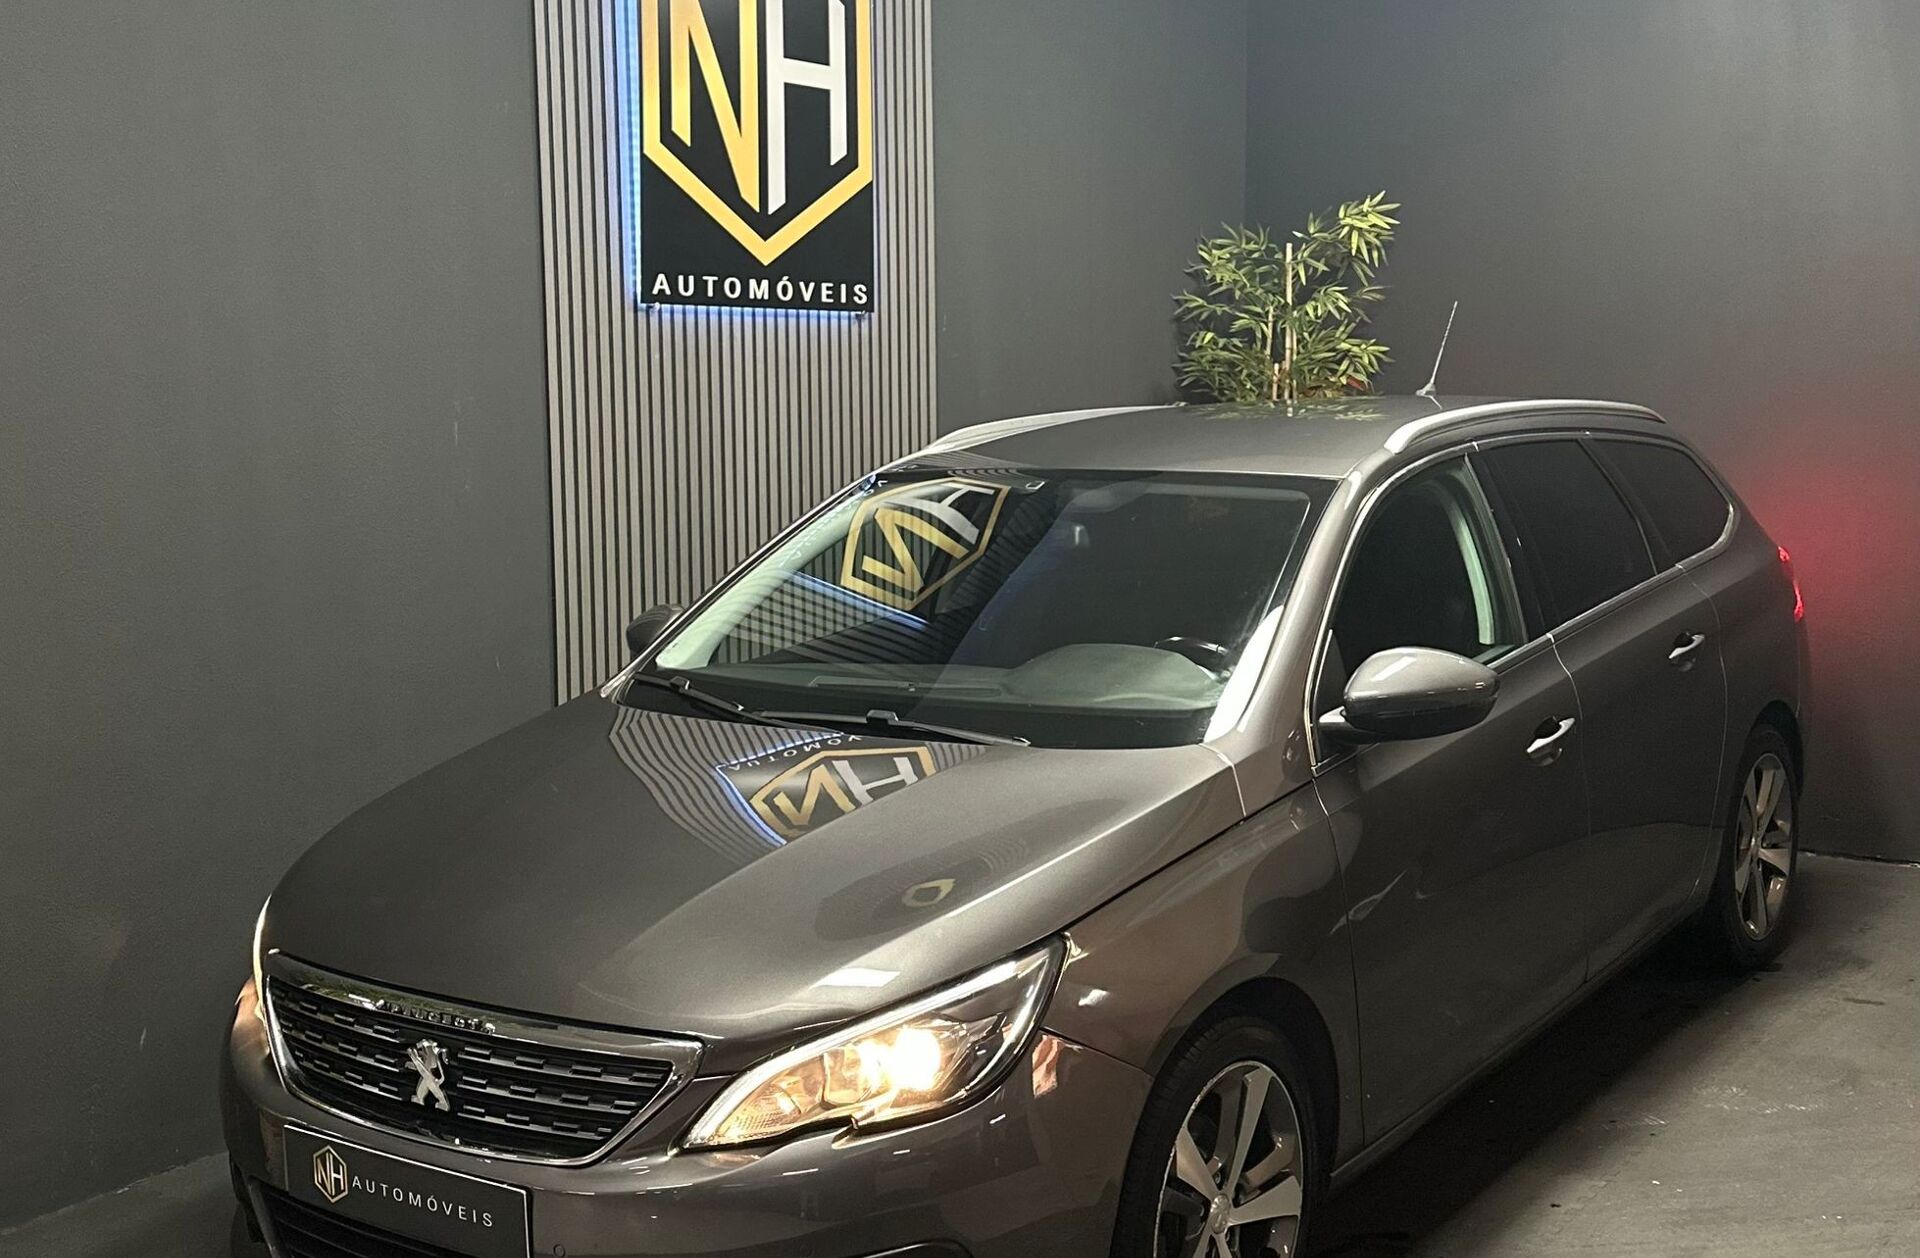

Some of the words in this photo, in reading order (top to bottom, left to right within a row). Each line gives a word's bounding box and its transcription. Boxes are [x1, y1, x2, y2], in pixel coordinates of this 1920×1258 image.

[669, 0, 848, 215] NH
[652, 272, 869, 304] AUTOMÓVEIS
[317, 1152, 344, 1197] NH
[352, 1175, 494, 1228] AUTOMÓVEIS
